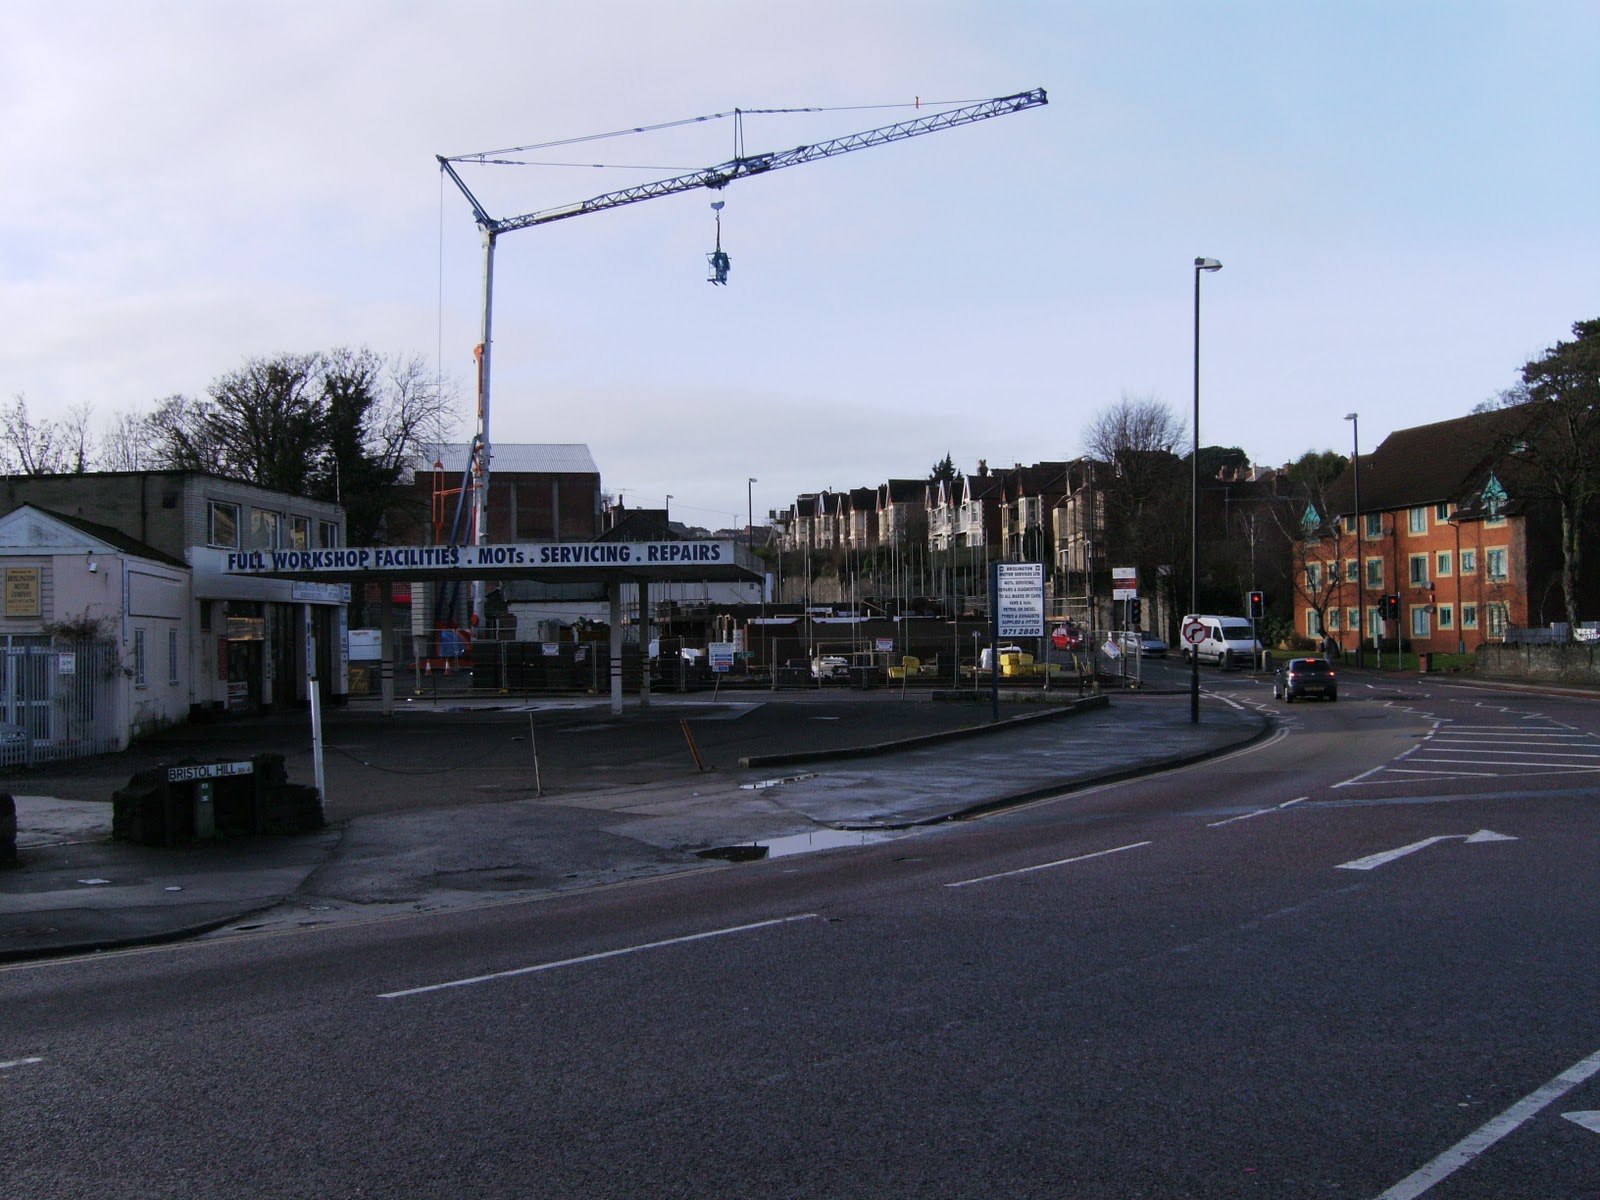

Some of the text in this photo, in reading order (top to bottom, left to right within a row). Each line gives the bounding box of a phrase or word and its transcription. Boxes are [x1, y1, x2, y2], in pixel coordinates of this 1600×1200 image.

[228, 548, 460, 570] FULL WORKSHOP FACILITIES
[478, 548, 524, 564] MOTs
[540, 545, 631, 564] SERVICING
[647, 544, 721, 562] REPAIRS
[169, 766, 212, 780] BRISTOL
[216, 764, 236, 775] HILL
